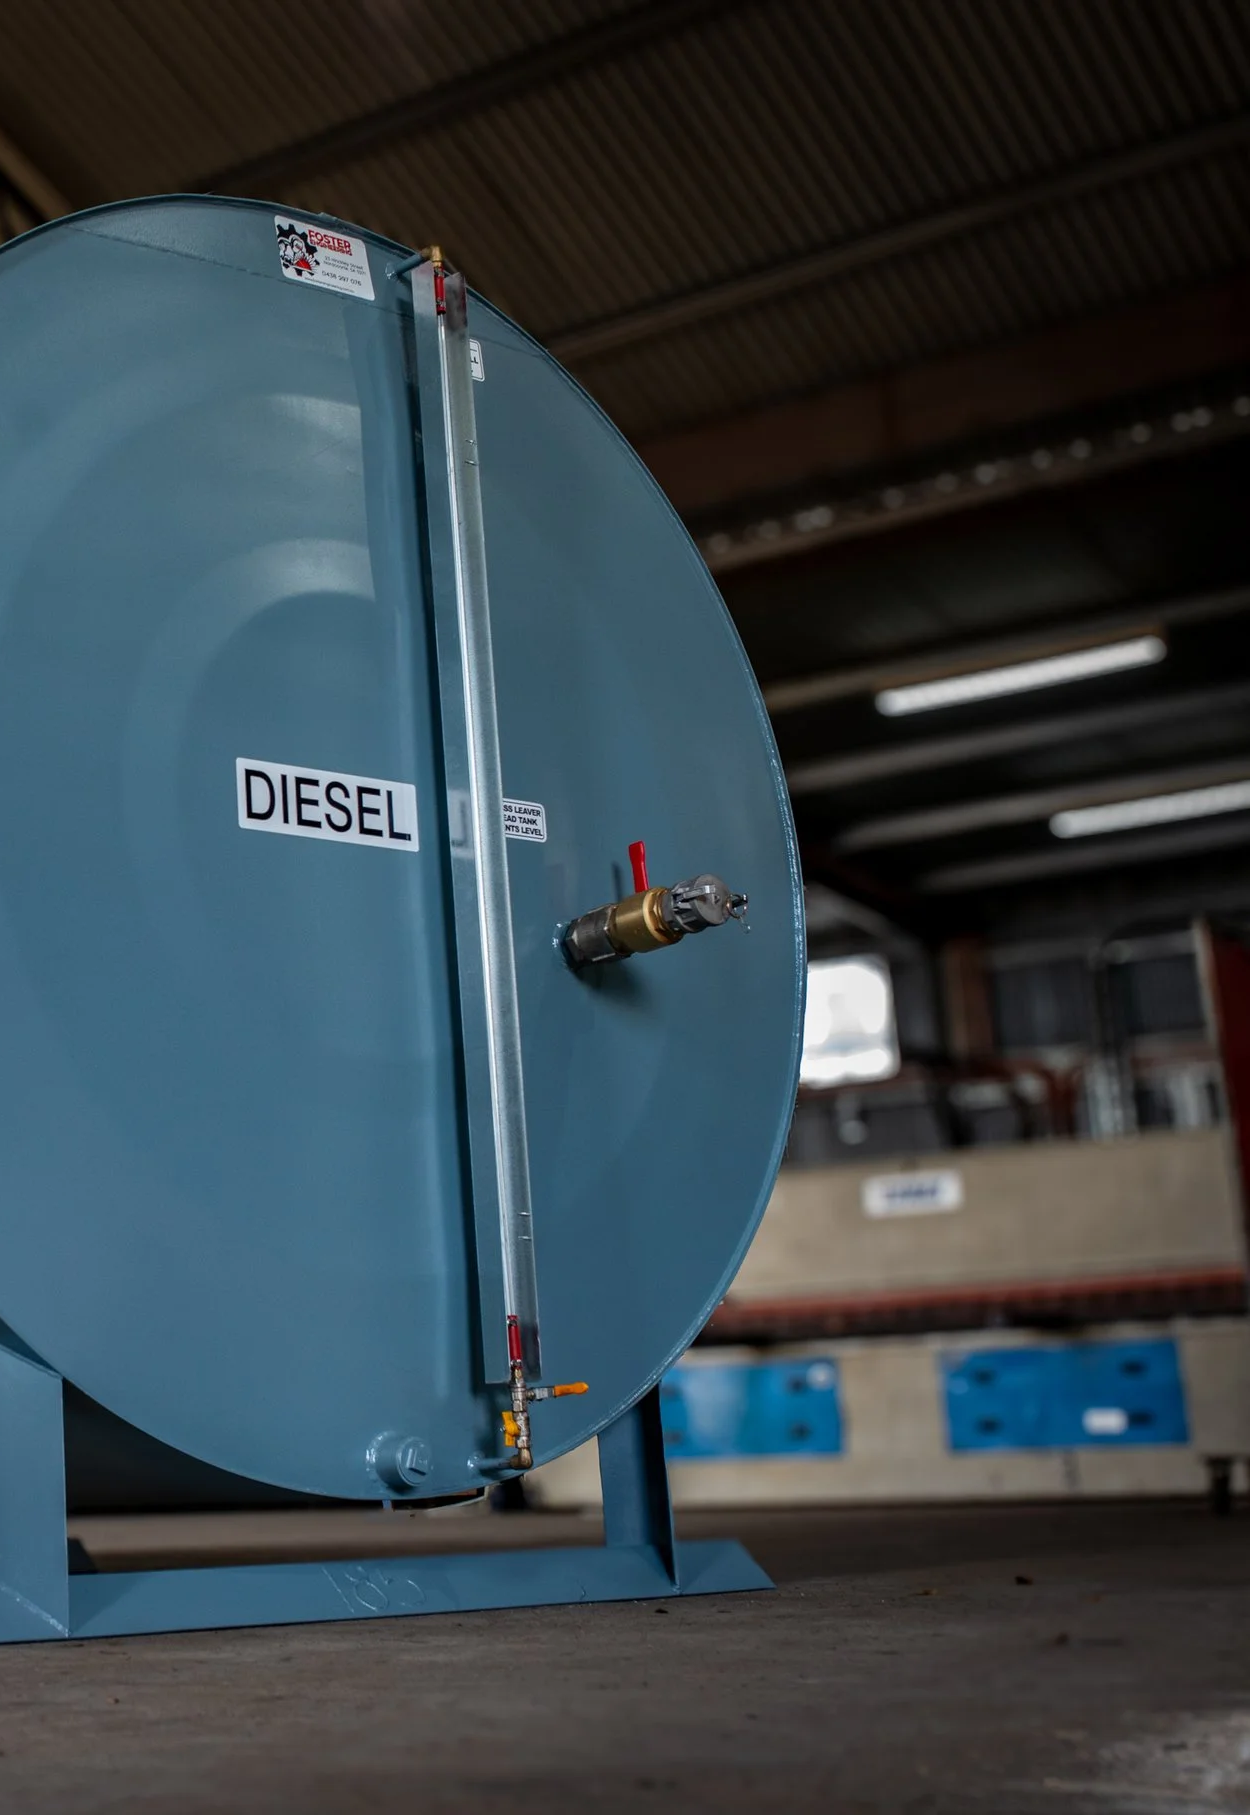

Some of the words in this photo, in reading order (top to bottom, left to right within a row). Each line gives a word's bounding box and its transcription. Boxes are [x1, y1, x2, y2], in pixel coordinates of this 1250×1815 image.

[308, 229, 351, 249] FOSTER
[244, 768, 411, 842] DIESEL
[503, 804, 513, 812] SS
[514, 806, 541, 817] LEAVER
[504, 814, 517, 823] EAD
[518, 816, 538, 826] TANK
[505, 824, 520, 833] NTS
[521, 826, 543, 837] LEVEL
